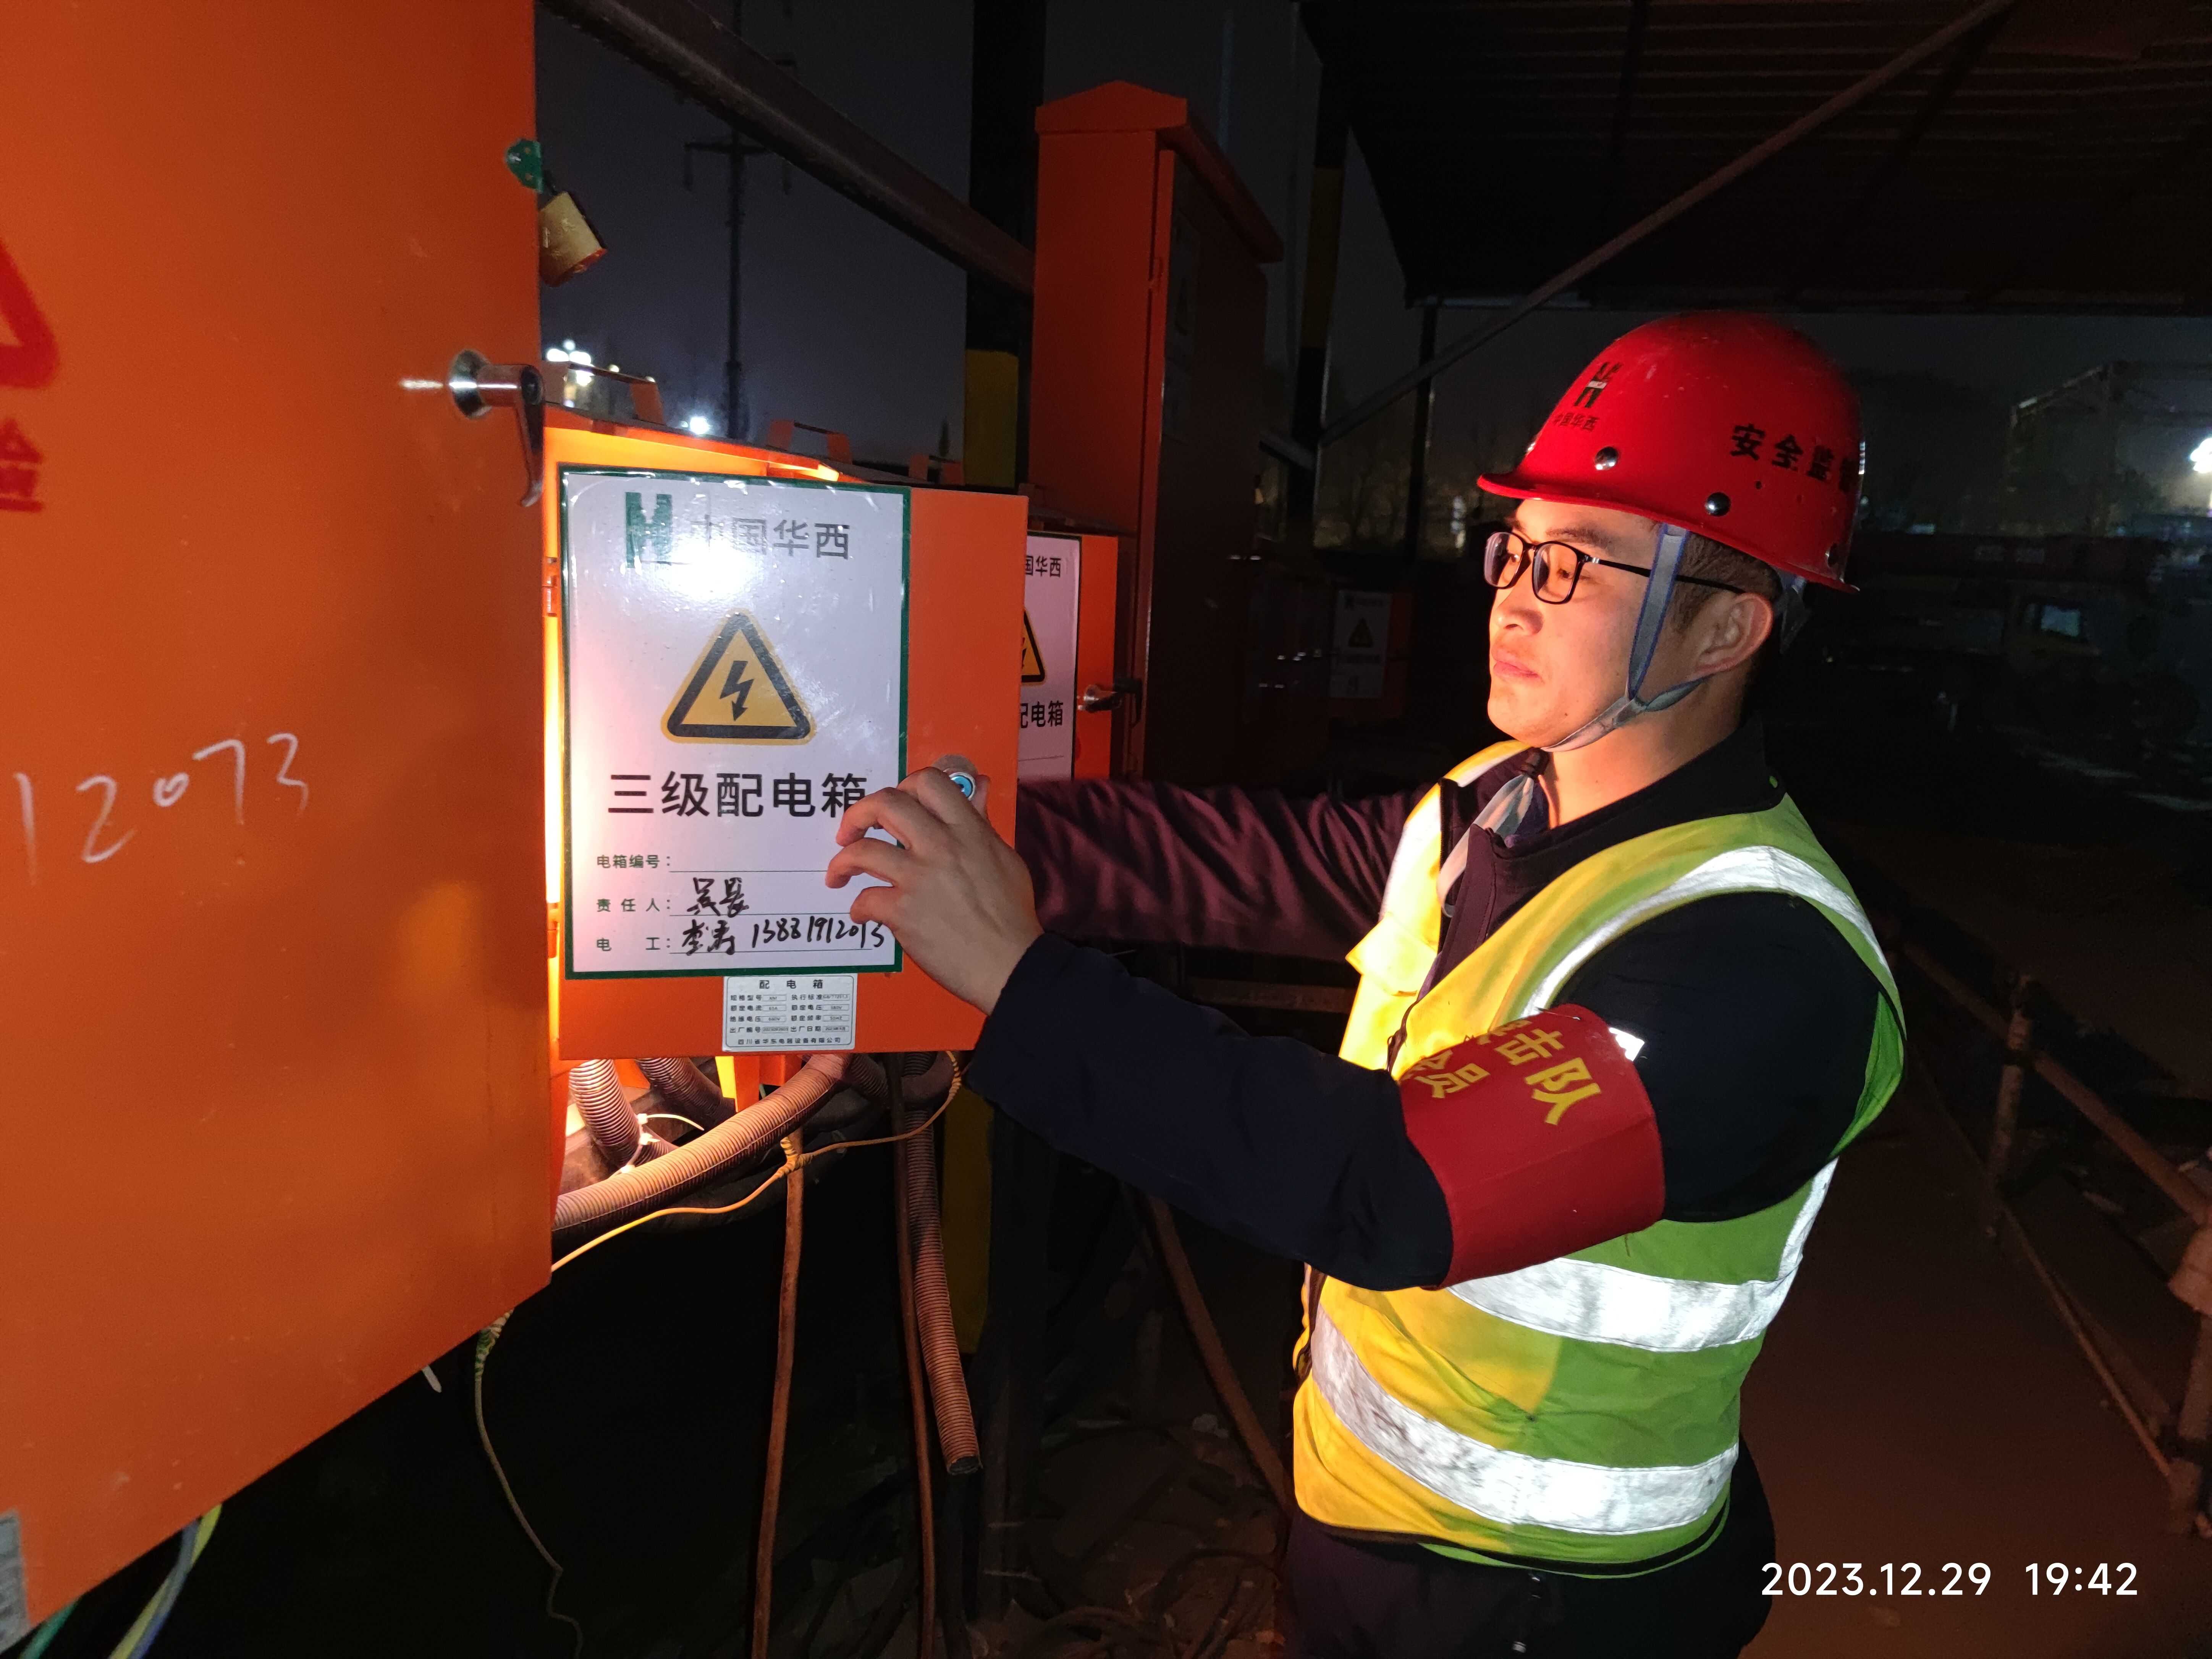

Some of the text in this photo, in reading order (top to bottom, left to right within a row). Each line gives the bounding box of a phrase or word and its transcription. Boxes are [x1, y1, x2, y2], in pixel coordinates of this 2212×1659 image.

[13, 732, 309, 885] 12073
[608, 770, 868, 818] 三级配电箱
[759, 979, 823, 989] 配电箱
